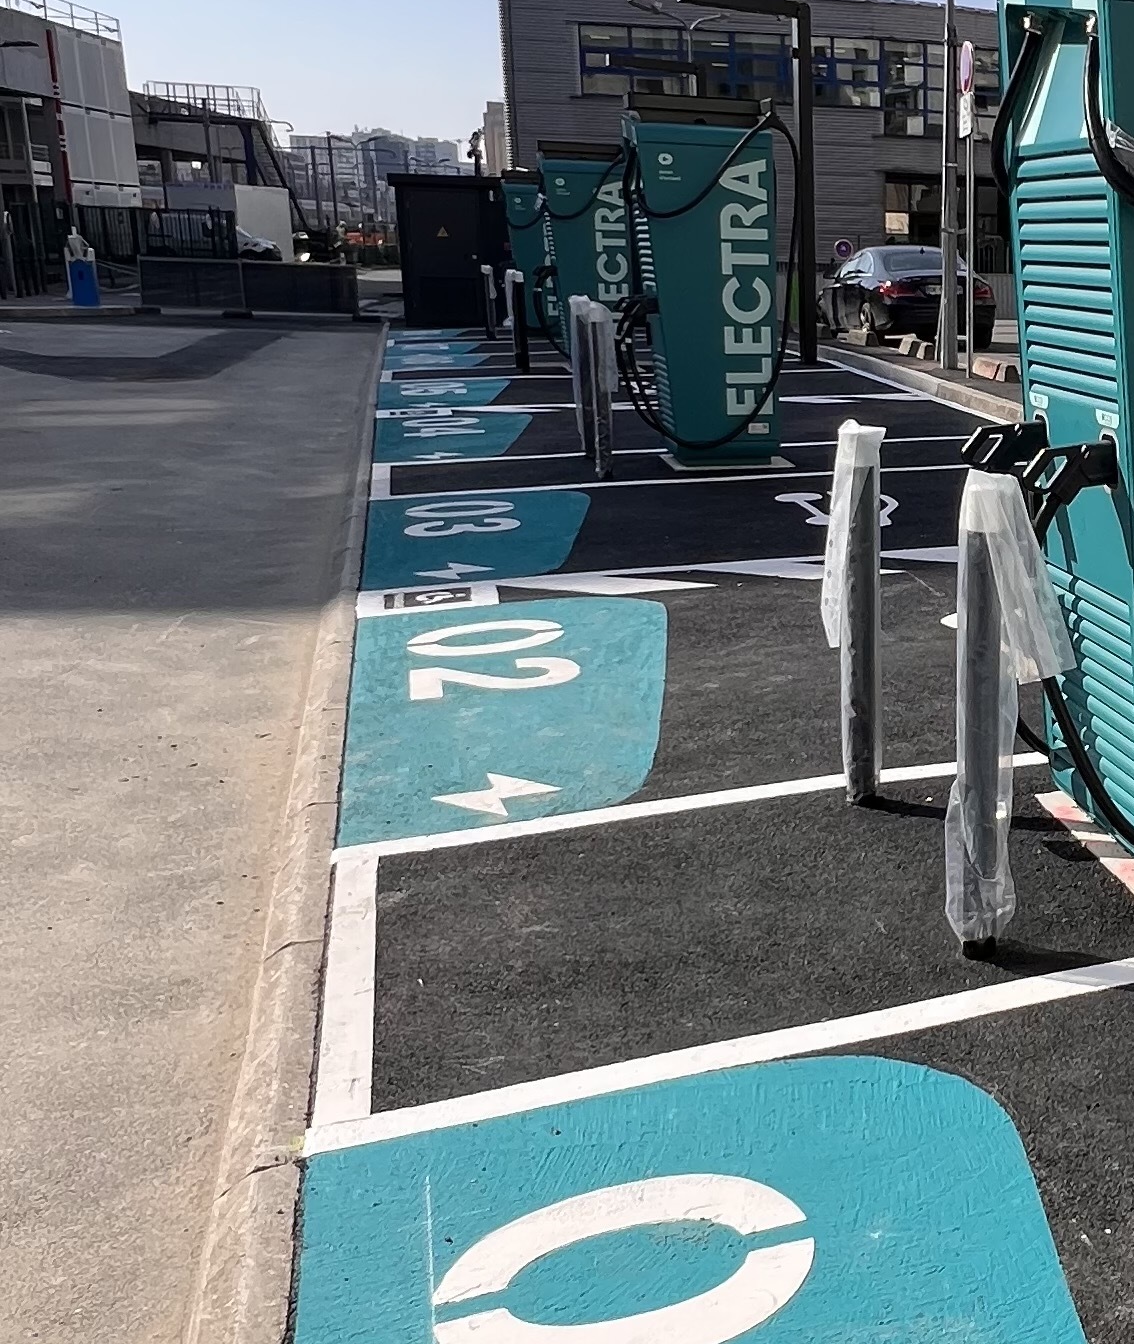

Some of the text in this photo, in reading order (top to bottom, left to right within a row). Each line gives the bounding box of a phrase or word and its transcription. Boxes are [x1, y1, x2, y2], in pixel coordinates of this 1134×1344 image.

[594, 180, 629, 320] ECTRA
[718, 158, 776, 418] ELECTRA
[404, 499, 521, 538] 03
[406, 618, 581, 701] 02
